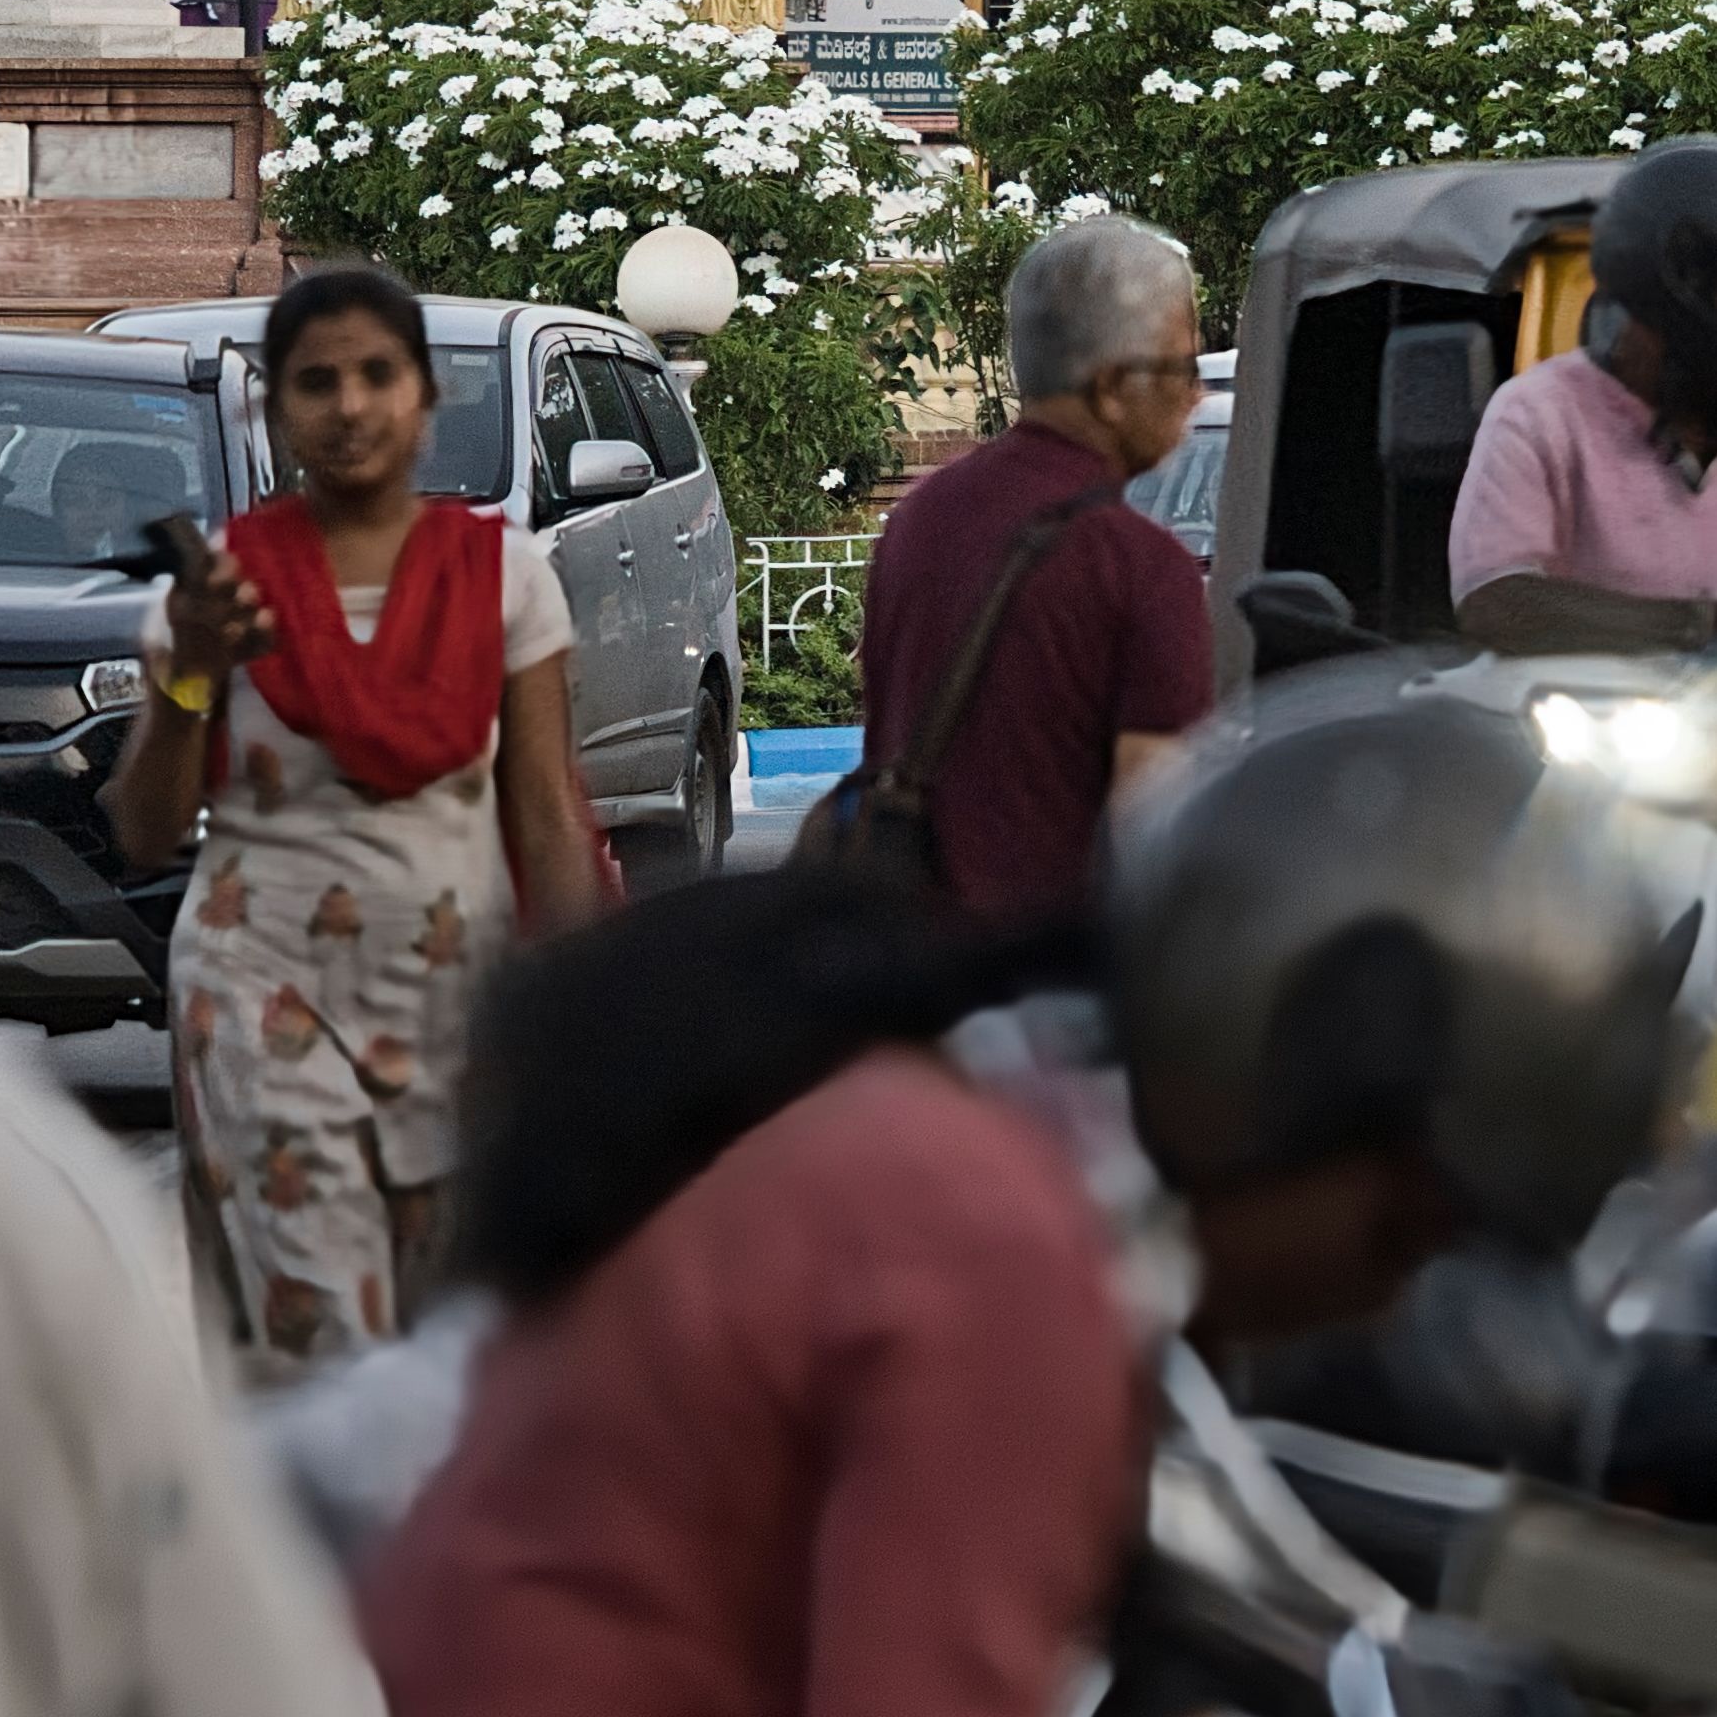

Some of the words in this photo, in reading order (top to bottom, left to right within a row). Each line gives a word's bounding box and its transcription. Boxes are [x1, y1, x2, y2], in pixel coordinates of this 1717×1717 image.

[816, 33, 871, 65] ಮೆಡಿಕಲ್ಸ್
[877, 39, 887, 60] &
[894, 36, 943, 60] ಜನರಲ್
[871, 72, 881, 89] &
[883, 71, 941, 89] GENERAL
